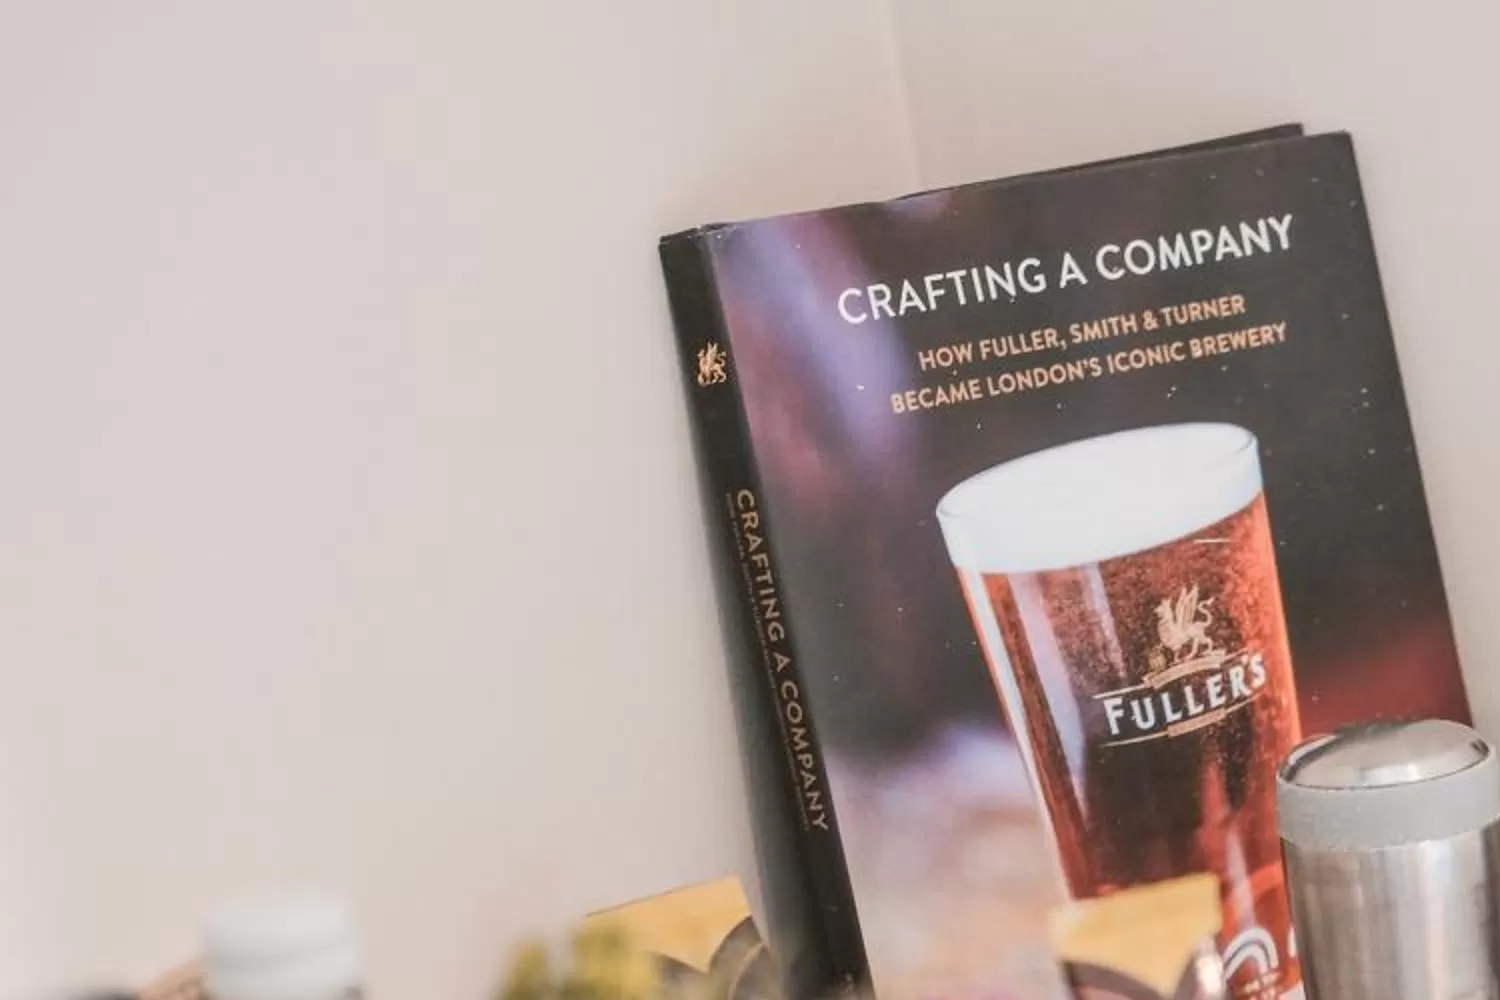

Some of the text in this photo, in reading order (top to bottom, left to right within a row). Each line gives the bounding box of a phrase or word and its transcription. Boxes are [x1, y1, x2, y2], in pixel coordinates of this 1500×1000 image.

[838, 214, 1293, 324] CRAFTING A COMPANY
[890, 320, 1287, 413] BECAME LONDON'S ICONIC BREWERY
[919, 294, 1246, 371] HOW FULLER, SMITH & TURNER
[737, 489, 785, 641] CRAFTING
[773, 652, 791, 672] A
[1103, 653, 1267, 736] FULLER'S
[781, 680, 828, 831] COMPANY
